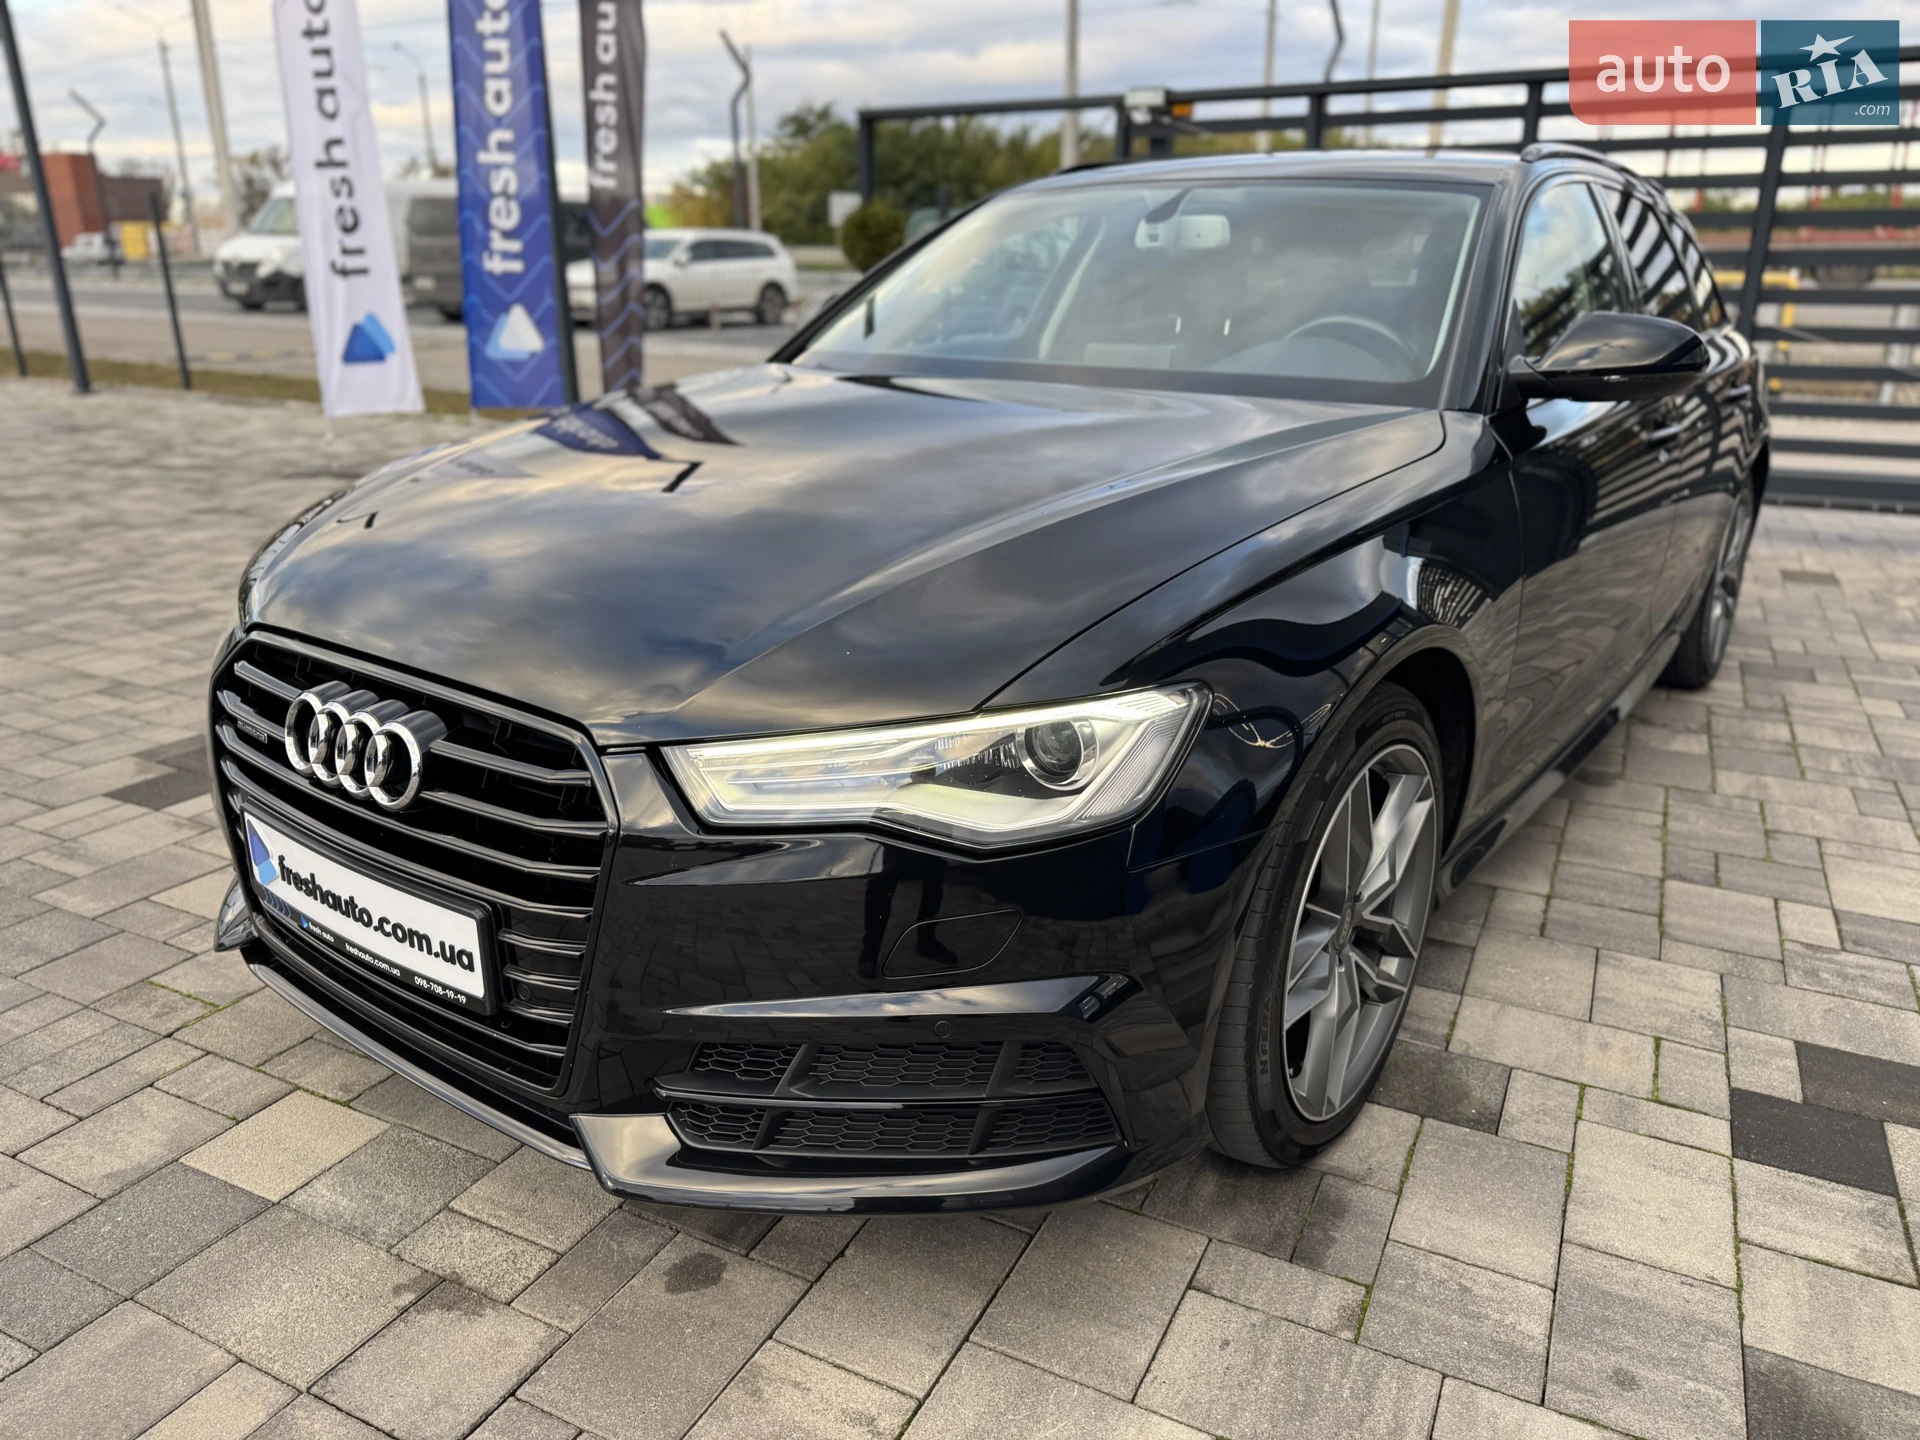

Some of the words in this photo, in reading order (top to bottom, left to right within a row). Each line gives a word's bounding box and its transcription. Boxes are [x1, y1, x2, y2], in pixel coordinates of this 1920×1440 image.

[475, 0, 513, 118] aut
[588, 73, 619, 190] fresh
[313, 137, 370, 279] fresh
[476, 128, 525, 276] fresh
[278, 855, 475, 972] freshauto.com.ua
[414, 976, 466, 1004] 098-708-19-19
